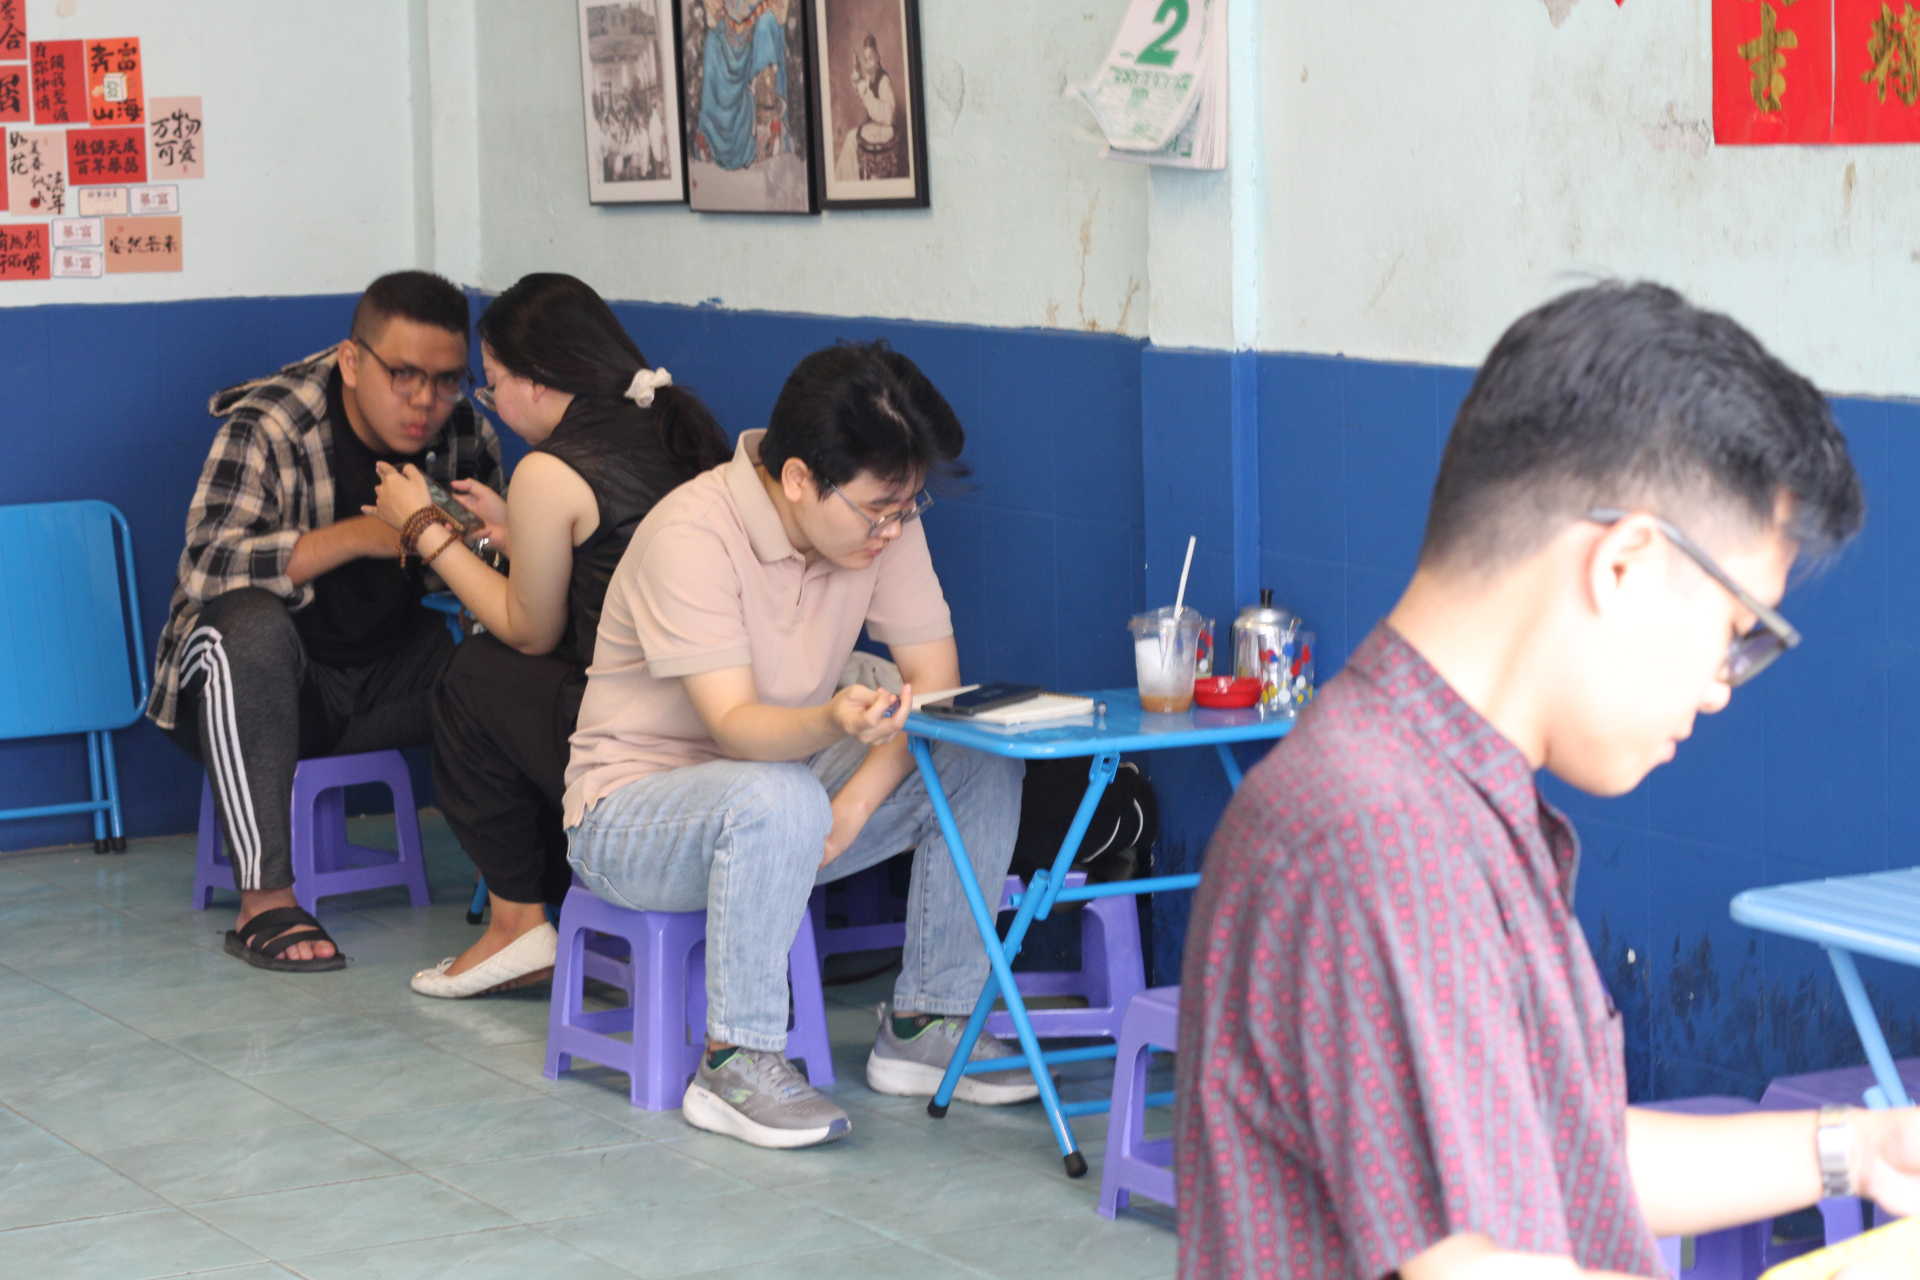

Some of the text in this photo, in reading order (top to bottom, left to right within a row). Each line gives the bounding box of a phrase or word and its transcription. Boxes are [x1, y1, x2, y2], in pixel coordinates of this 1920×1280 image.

[1135, 0, 1190, 67] 2
[1738, 0, 1798, 114] 吉
[93, 99, 143, 122] 山海
[151, 109, 201, 138] 万物
[74, 137, 139, 157] 佳偶天成
[154, 140, 197, 167] 可爱
